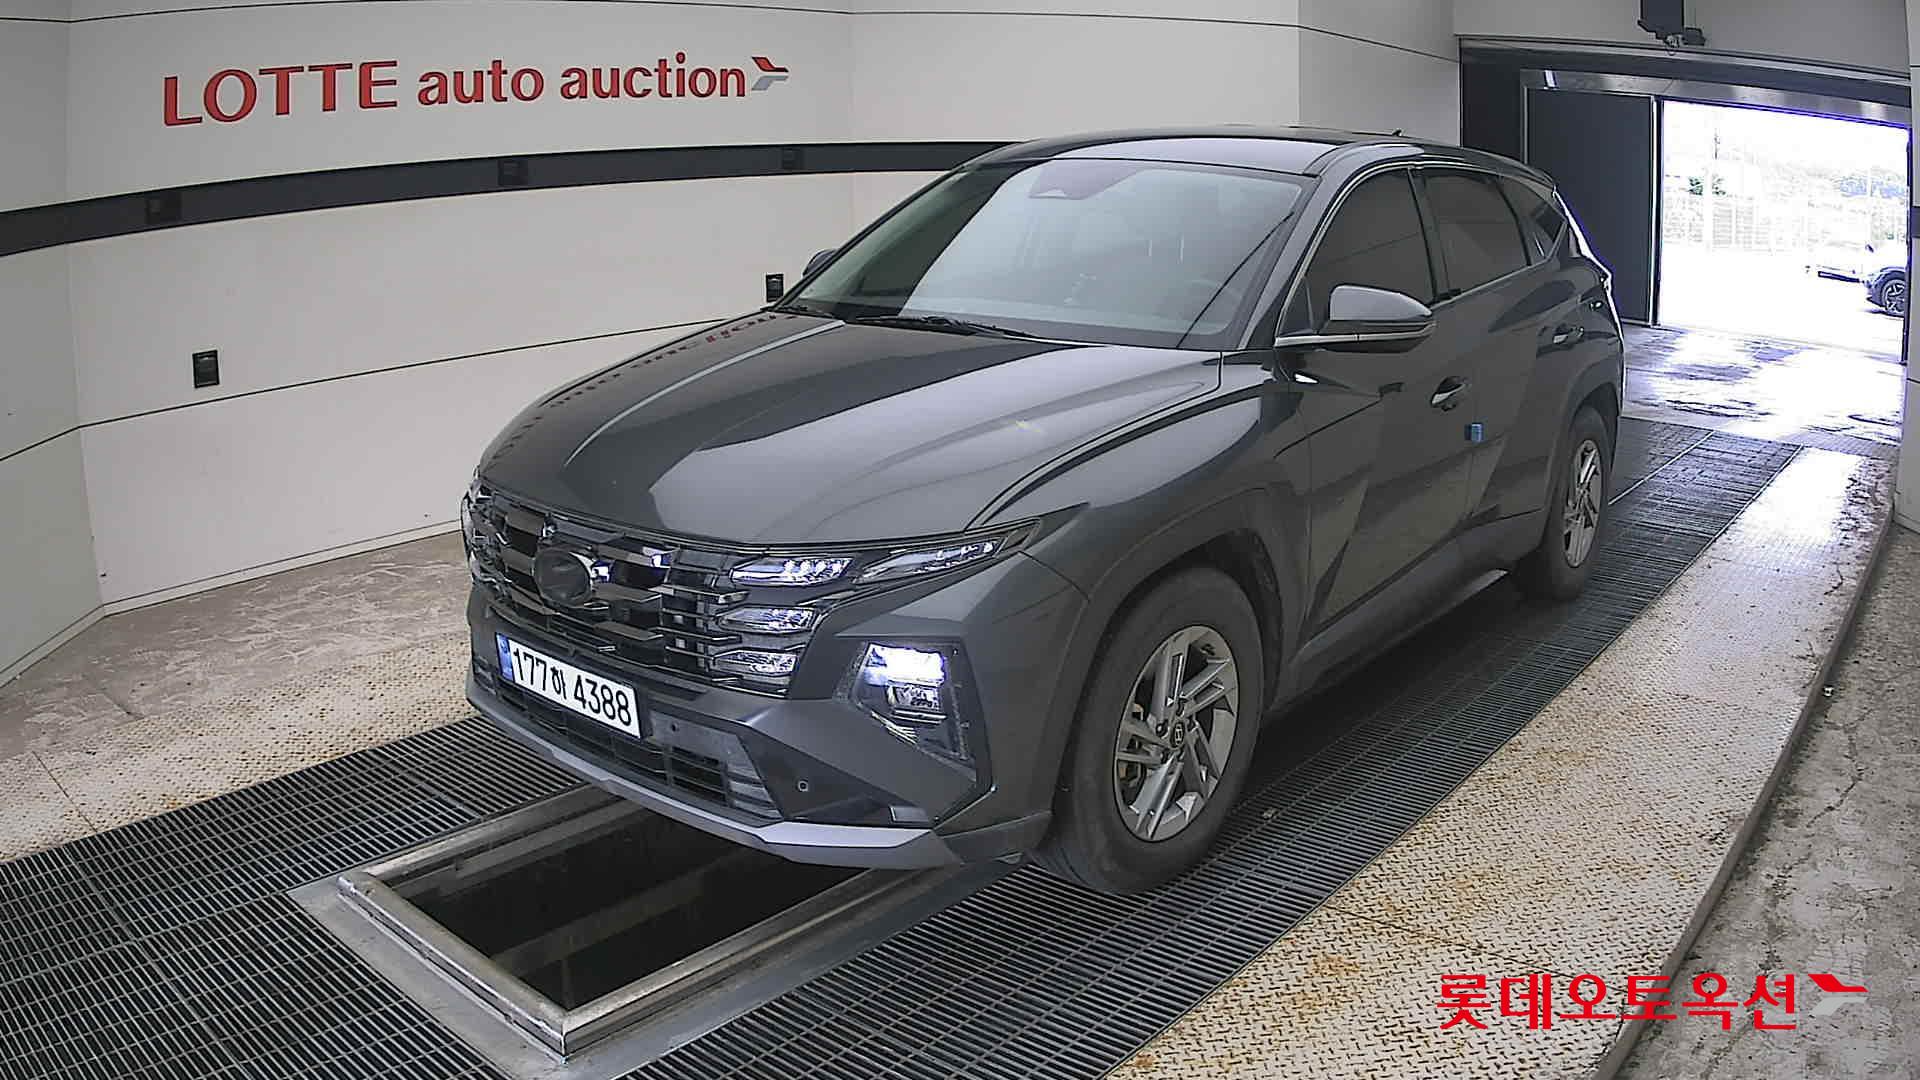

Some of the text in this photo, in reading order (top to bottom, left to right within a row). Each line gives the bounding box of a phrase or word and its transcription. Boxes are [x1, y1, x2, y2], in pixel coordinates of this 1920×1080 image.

[163, 51, 746, 127] LOTTE auto auction
[513, 648, 632, 727] 177하 4388
